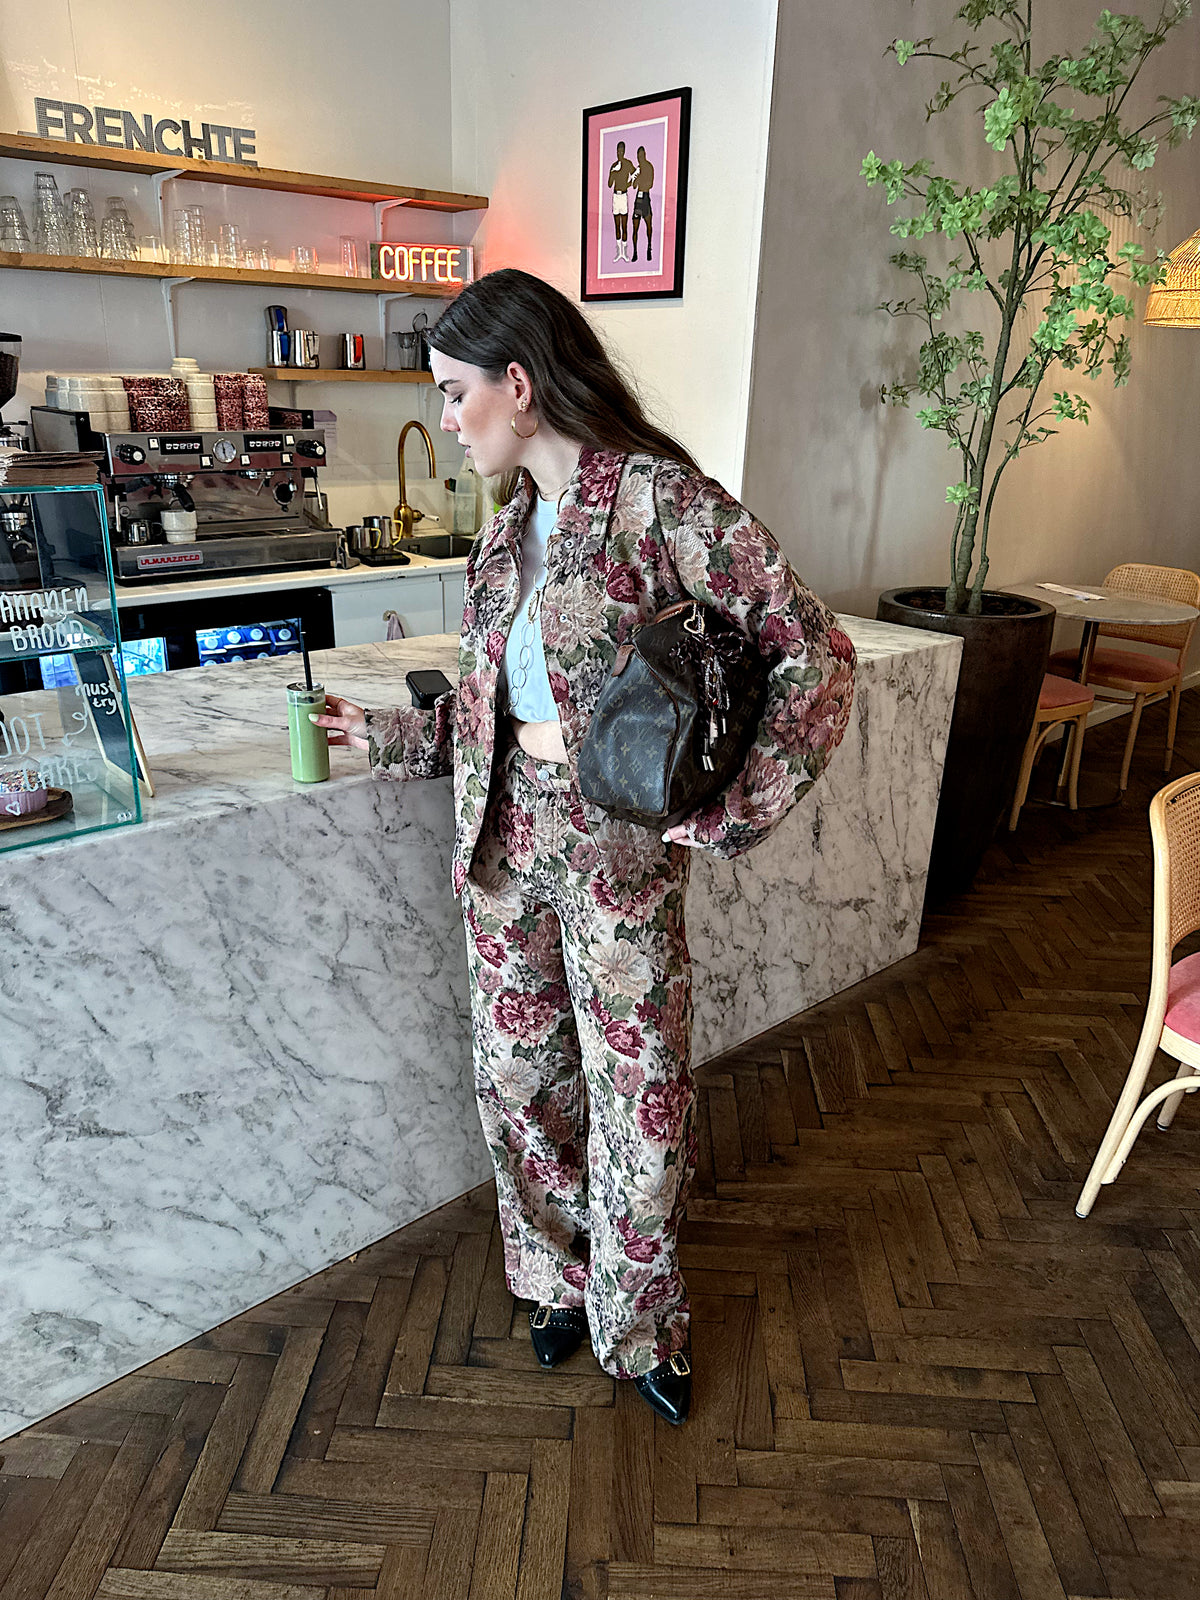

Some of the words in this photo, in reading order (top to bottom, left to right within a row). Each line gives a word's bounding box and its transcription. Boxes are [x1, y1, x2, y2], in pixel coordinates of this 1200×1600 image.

[34, 97, 258, 167] FRENCHIE
[379, 245, 462, 282] COFFEE
[10, 620, 84, 651] BROOD
[92, 697, 117, 715] try
